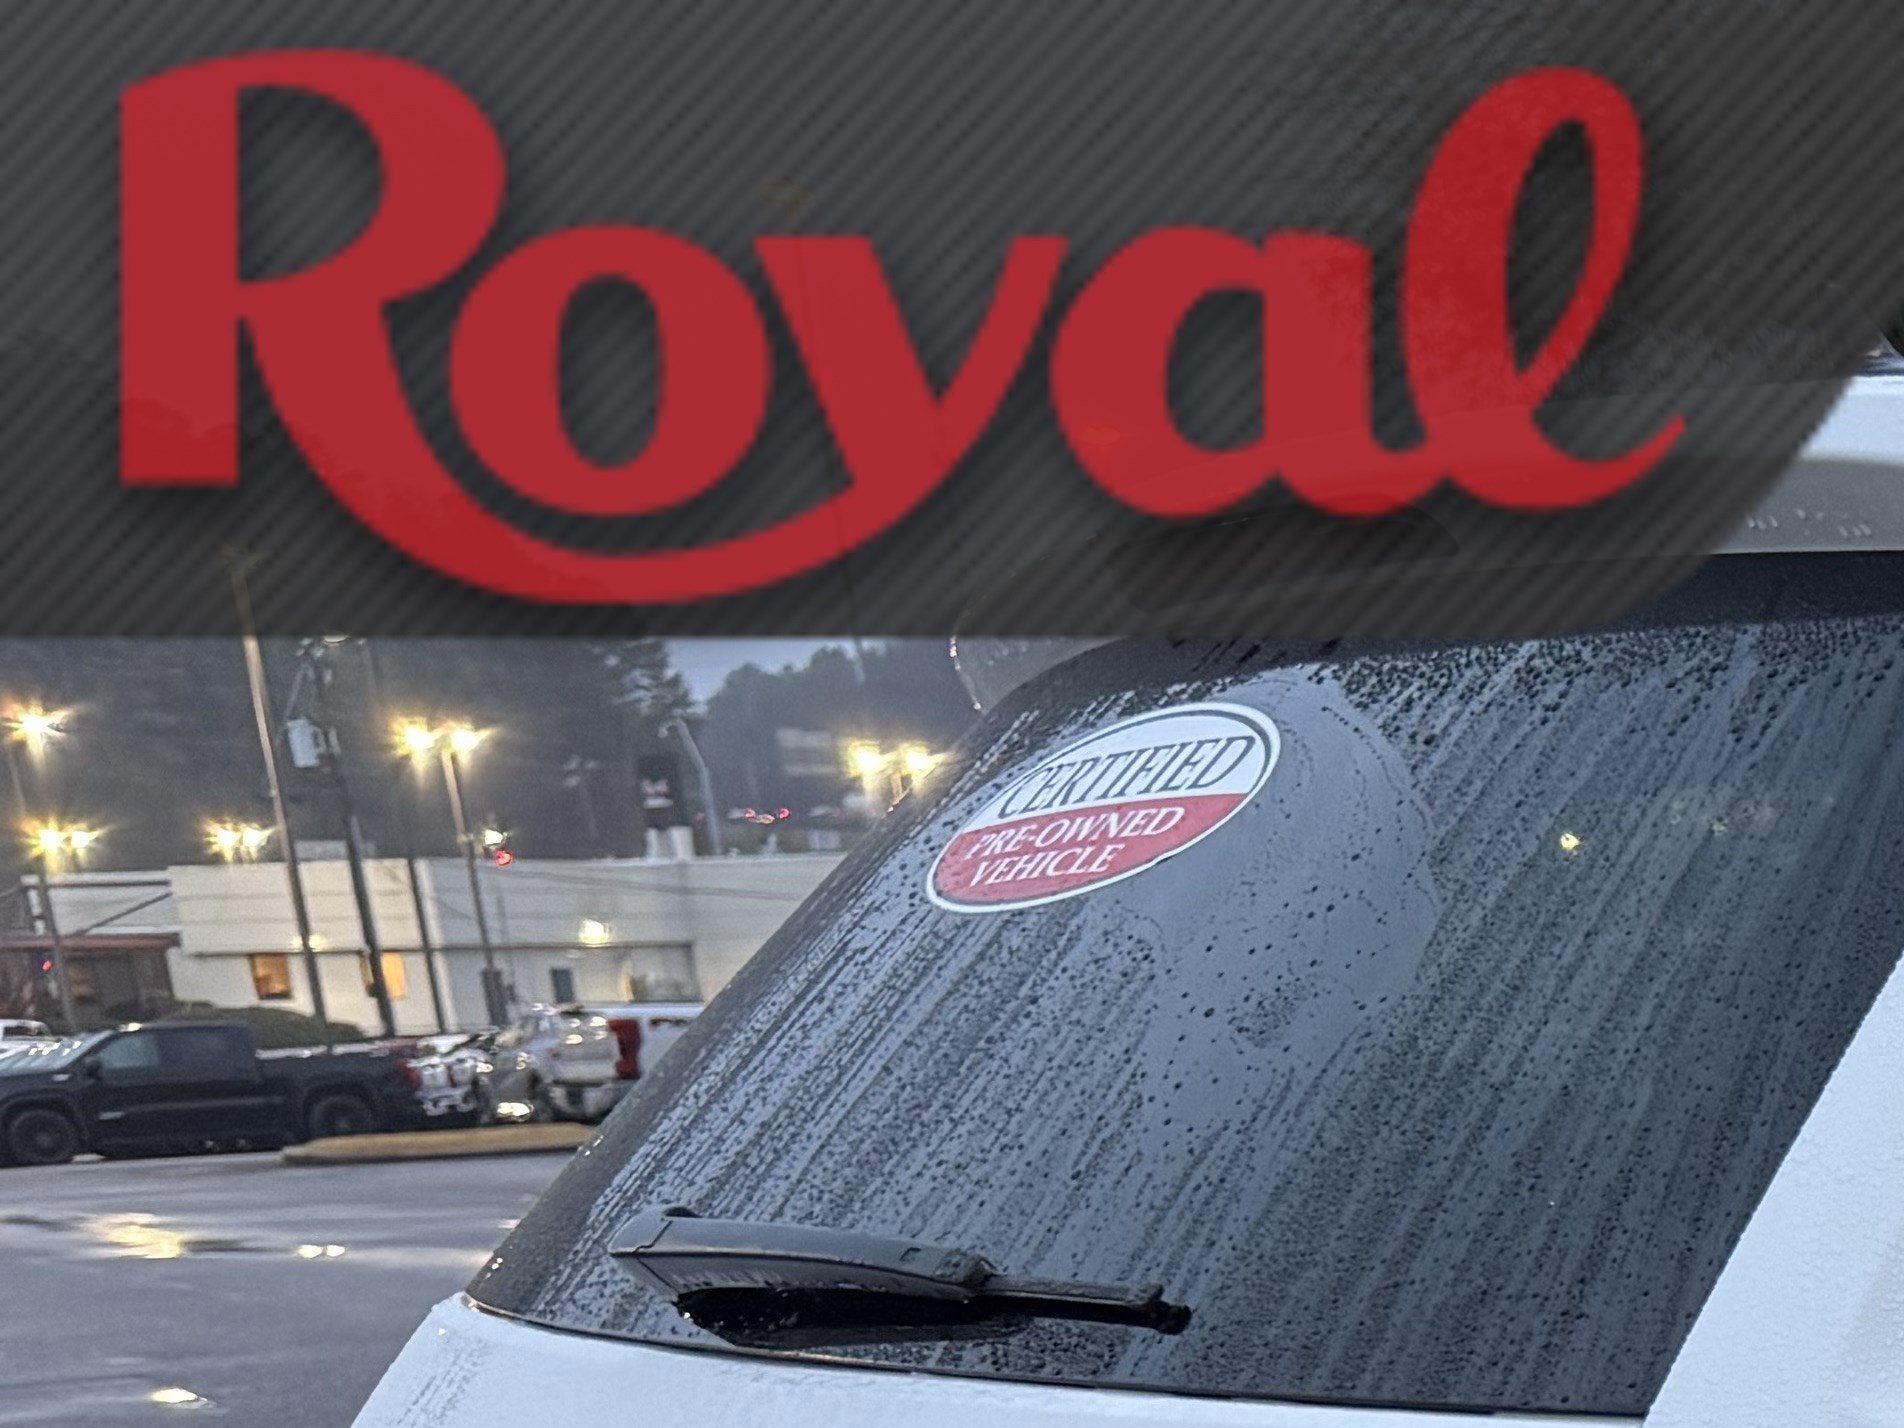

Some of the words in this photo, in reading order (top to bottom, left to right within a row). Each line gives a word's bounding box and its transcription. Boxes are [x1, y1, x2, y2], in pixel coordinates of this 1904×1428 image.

[998, 735, 1256, 819] CERTIFIED
[965, 806, 1185, 861] PRE-OWNED
[968, 844, 1124, 888] VEHICLE
